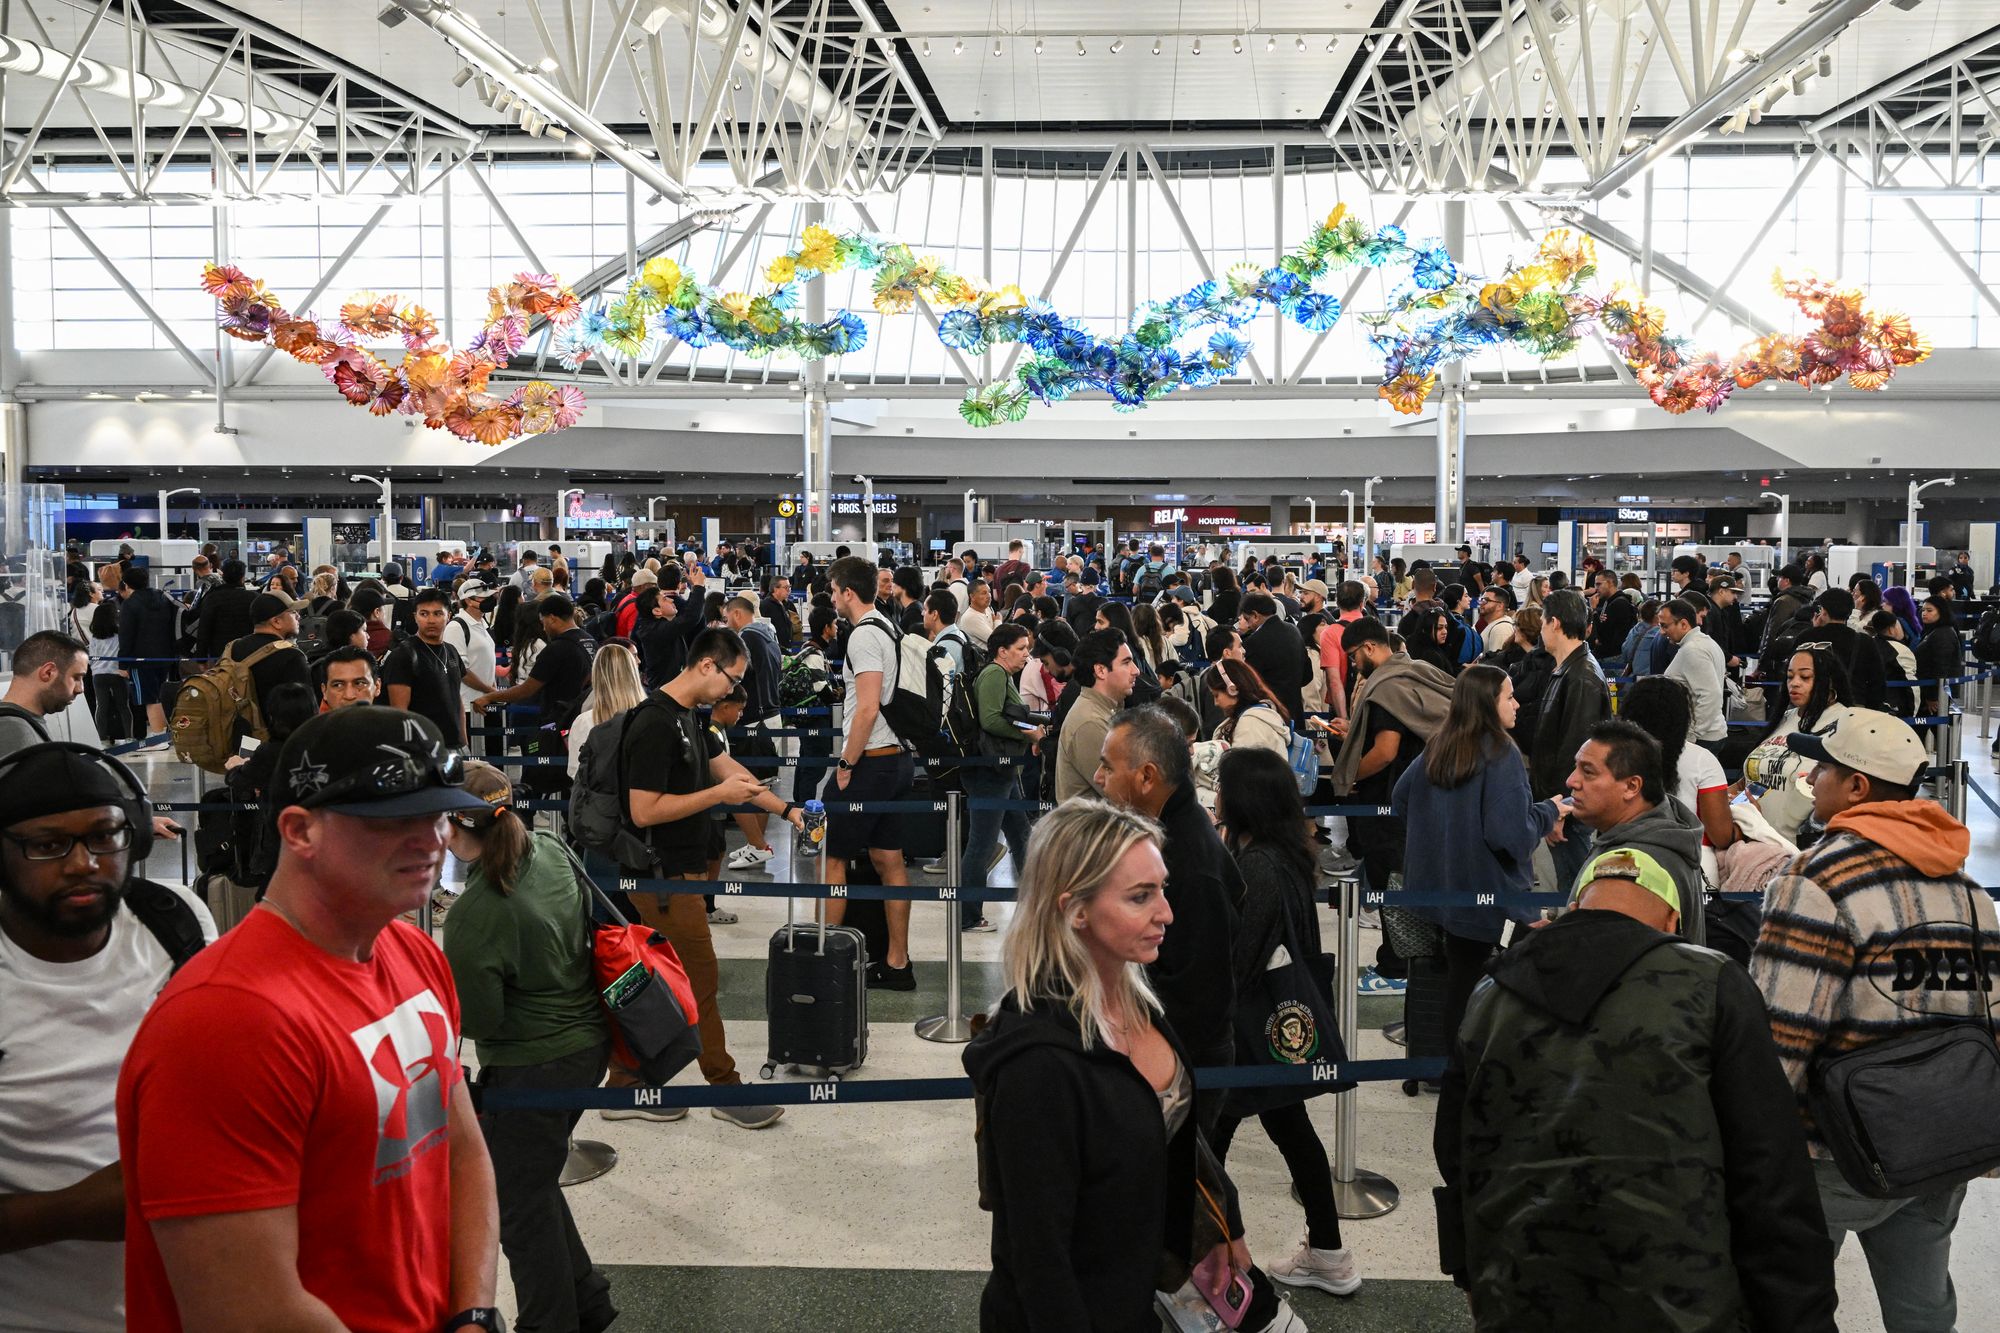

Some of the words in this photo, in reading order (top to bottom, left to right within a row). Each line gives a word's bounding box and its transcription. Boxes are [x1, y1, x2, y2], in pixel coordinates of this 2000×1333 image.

[864, 503, 897, 514] AGELS
[1618, 508, 1649, 521] iStore
[1198, 517, 1236, 525] HOUSTON
[1915, 717, 1927, 725] IAH
[786, 758, 798, 766] IAH
[928, 758, 940, 766] IAH
[999, 757, 1011, 765] IAH
[516, 800, 530, 809] IAH
[849, 802, 863, 812] IAH
[933, 801, 947, 811] IAH
[1039, 802, 1053, 811] IAH
[1377, 806, 1391, 815] IAH
[619, 879, 637, 890] IAH
[725, 882, 742, 894] IAH
[830, 885, 848, 897] IAH
[939, 887, 957, 899] IAH
[1366, 891, 1384, 903] IAH
[1476, 893, 1494, 905] IAH
[1312, 1064, 1338, 1082] IAH
[634, 1088, 662, 1105] IAH
[810, 1084, 837, 1101] IAH
